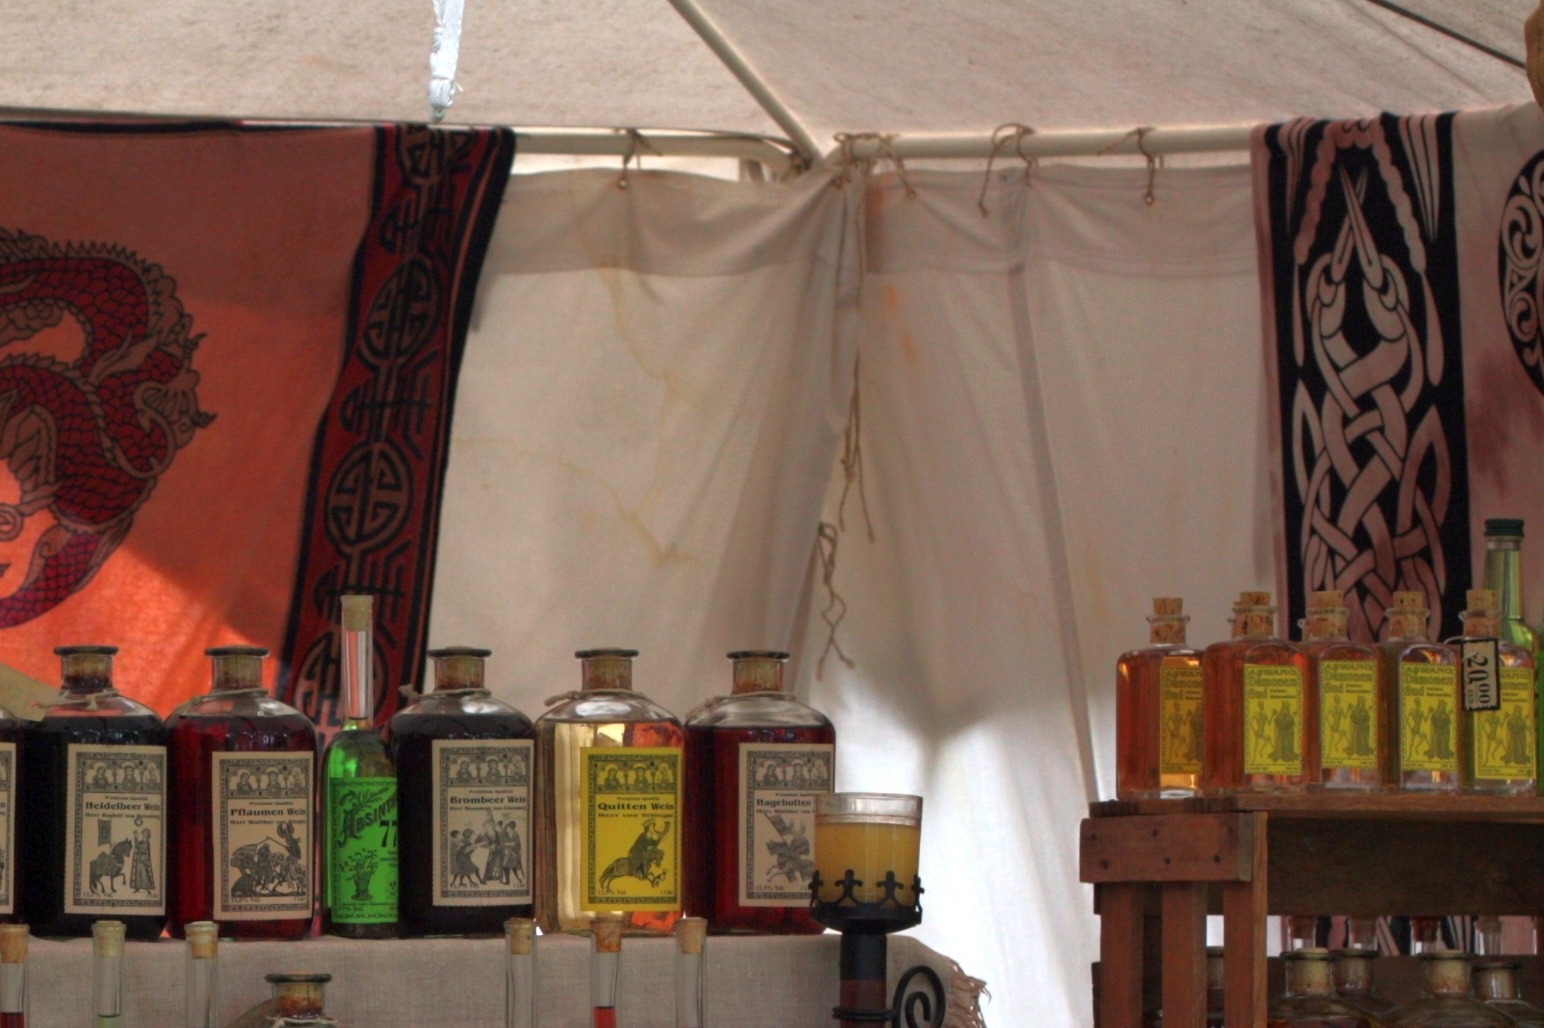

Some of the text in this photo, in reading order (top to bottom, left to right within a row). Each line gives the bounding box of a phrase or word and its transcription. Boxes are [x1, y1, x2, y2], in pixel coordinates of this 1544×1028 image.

[450, 796, 505, 804] Brombeer
[756, 798, 811, 808] Hagebutten
[85, 802, 161, 811] Heidelbeer Wein
[598, 802, 674, 811] Quitten Wein
[230, 808, 306, 816] Pflaumen Wein
